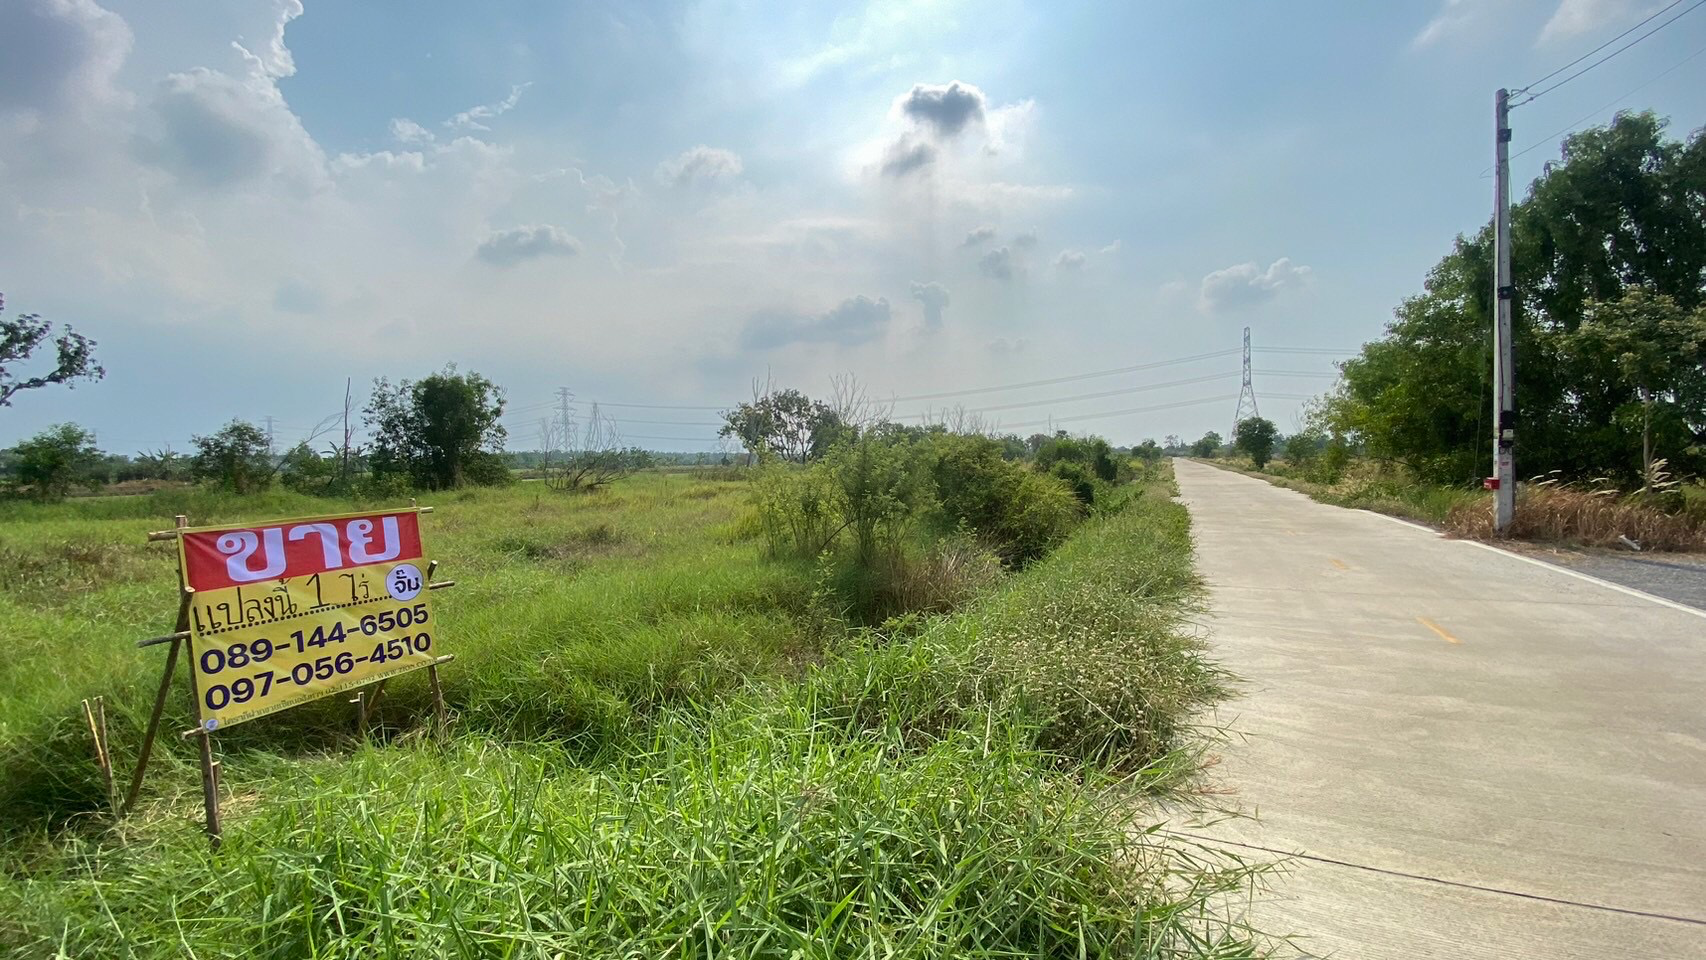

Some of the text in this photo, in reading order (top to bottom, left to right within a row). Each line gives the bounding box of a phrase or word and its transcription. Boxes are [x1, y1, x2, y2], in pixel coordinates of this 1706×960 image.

[216, 516, 400, 582] ขาย
[193, 573, 369, 632] แปลงนี้ 1 ไร่
[200, 603, 429, 675] 089-144-6505
[205, 632, 431, 710] 097-056-4510
